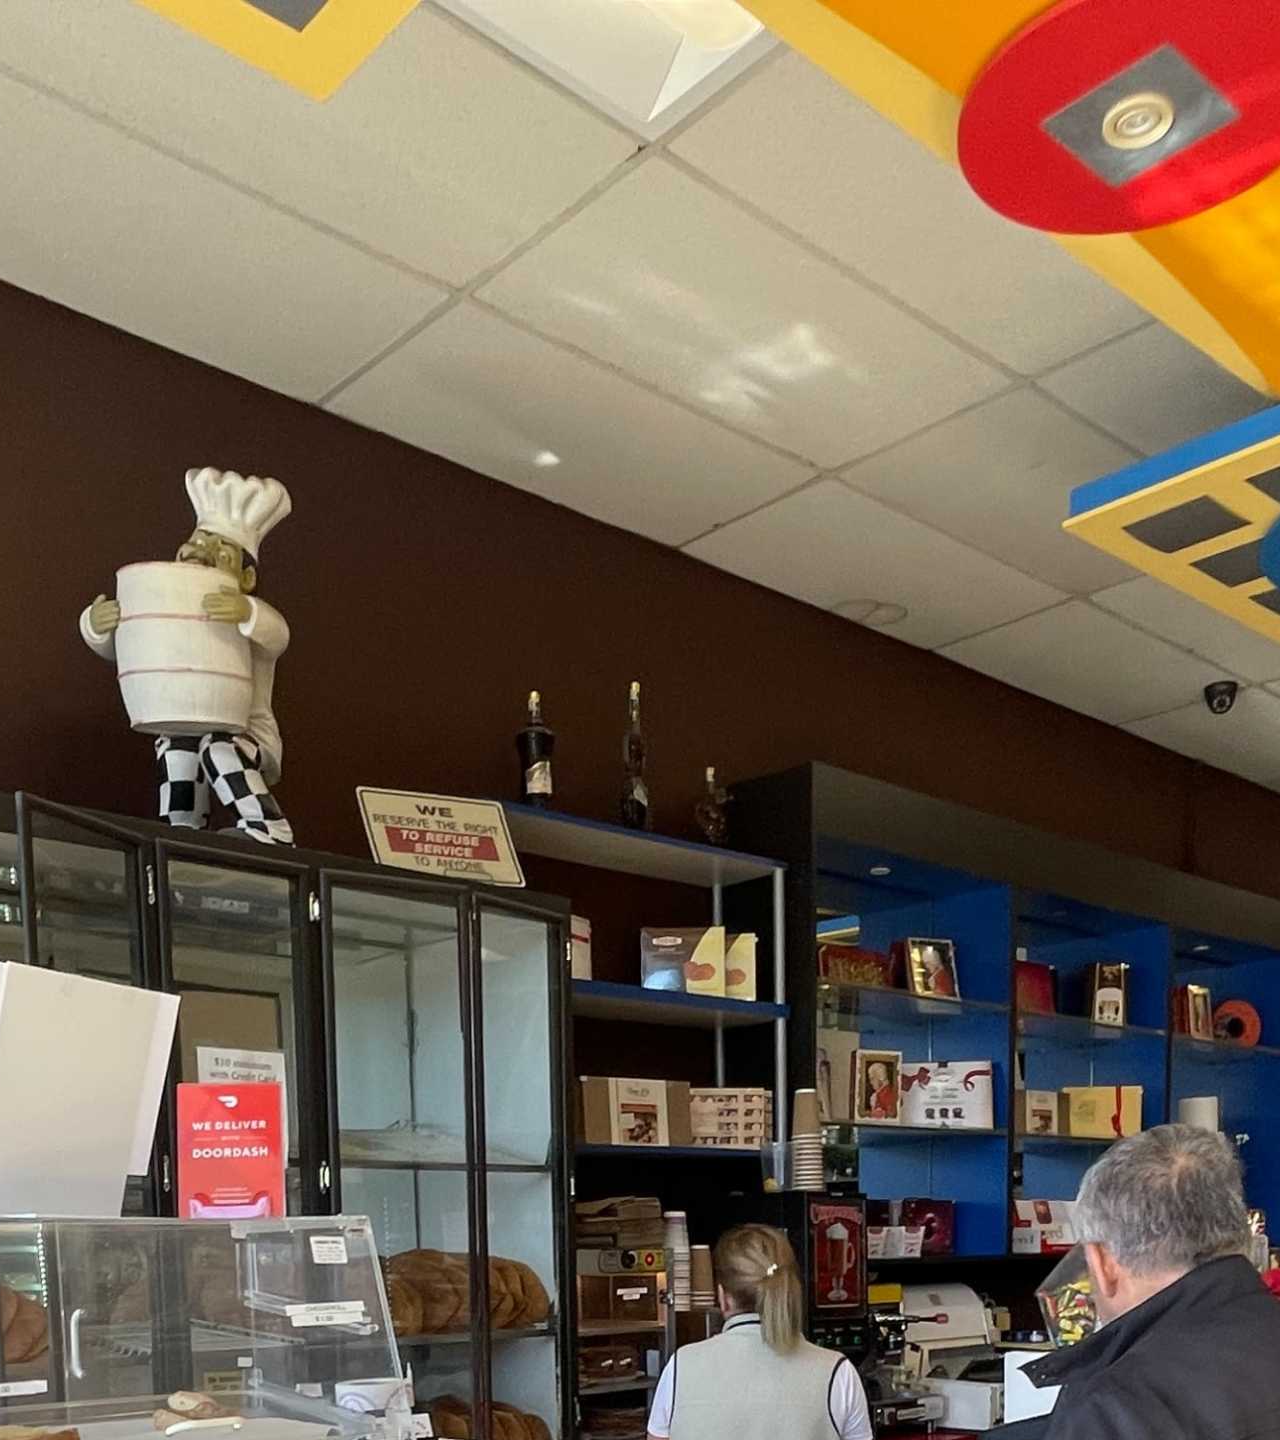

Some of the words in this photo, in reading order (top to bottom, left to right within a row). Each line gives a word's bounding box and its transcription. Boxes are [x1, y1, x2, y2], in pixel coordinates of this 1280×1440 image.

[415, 803, 454, 818] WE
[372, 813, 431, 829] RESERVE
[437, 819, 457, 831] THE
[463, 822, 499, 835] RIGHT
[400, 829, 420, 841] TO
[426, 831, 480, 847] REFUSE
[414, 843, 473, 858] SERVICE
[415, 855, 431, 867] TO
[436, 857, 485, 872] ANYONE
[192, 1120, 212, 1131] WE
[215, 1119, 267, 1131] DELIVER
[192, 1146, 269, 1160] DOORDASH
